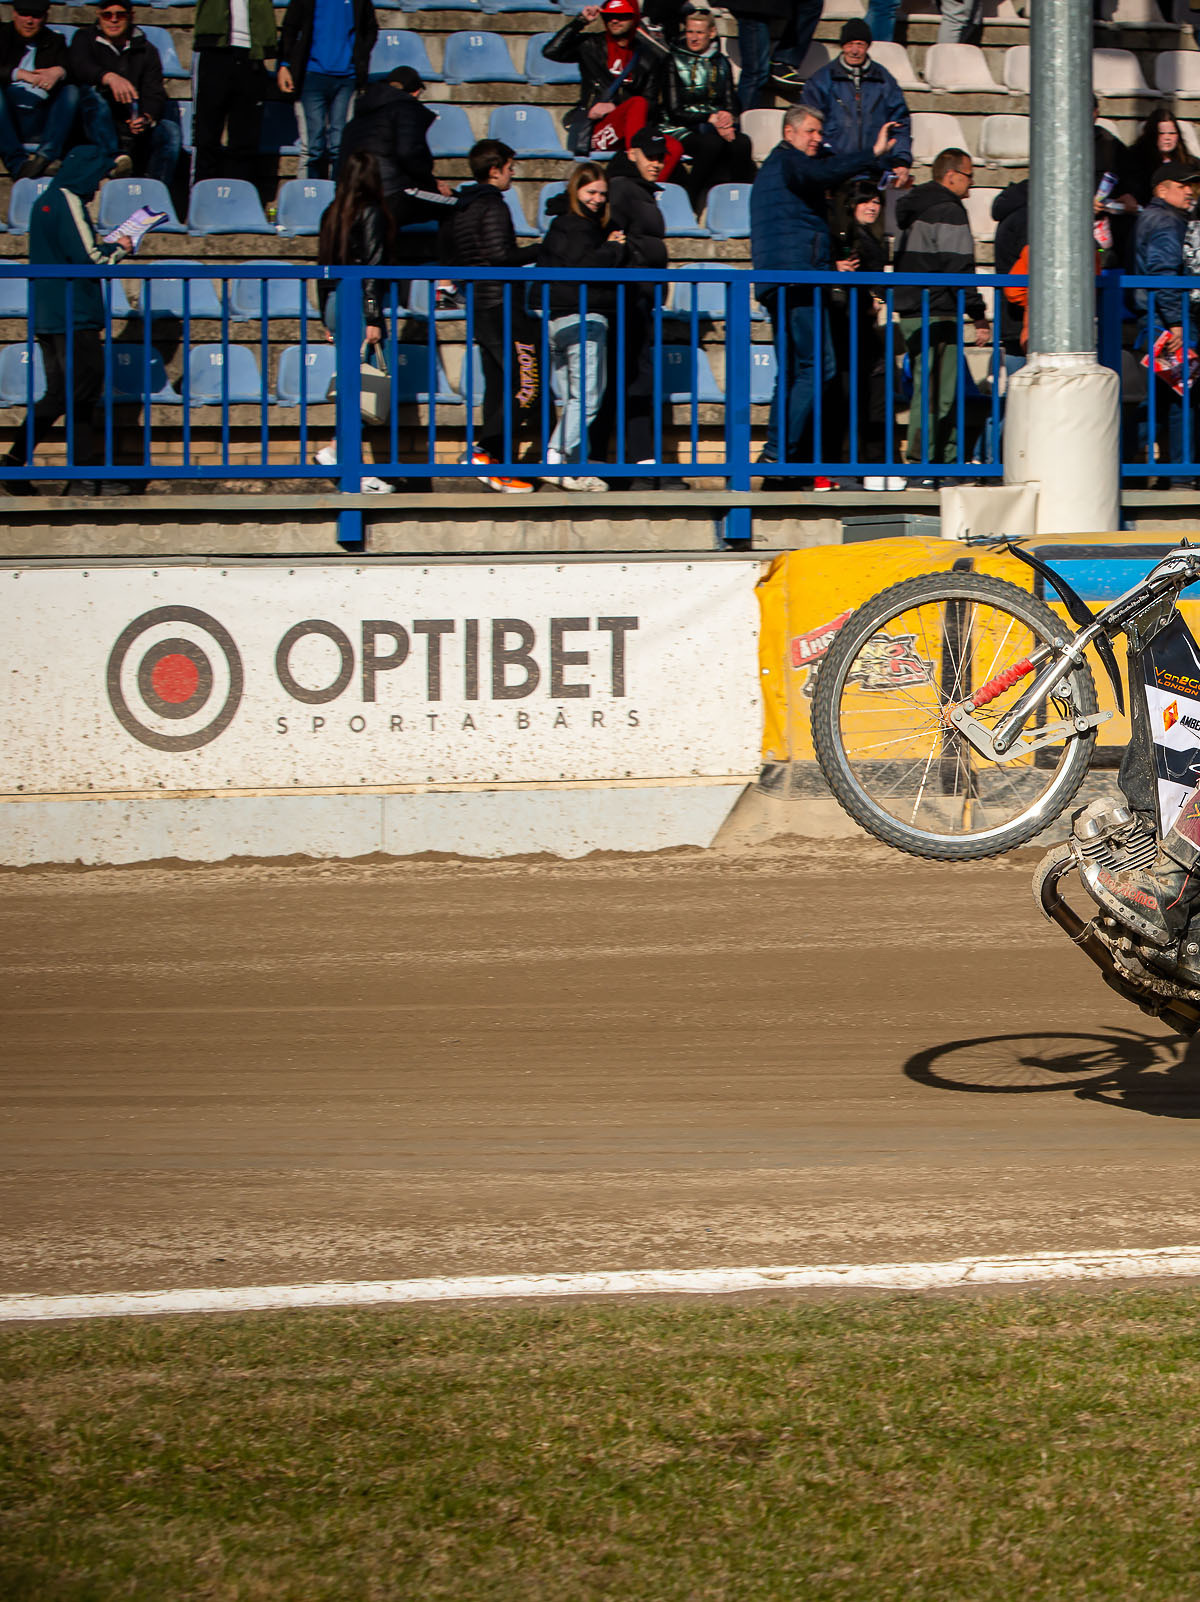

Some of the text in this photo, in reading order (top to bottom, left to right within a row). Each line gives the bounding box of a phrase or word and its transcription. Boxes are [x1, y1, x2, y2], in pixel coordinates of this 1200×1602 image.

[217, 186, 231, 198] 17
[753, 353, 770, 366] 12
[275, 616, 639, 705] OPTIBET
[1157, 678, 1199, 696] LONDON
[276, 706, 640, 735] SPORTA BĀRS
